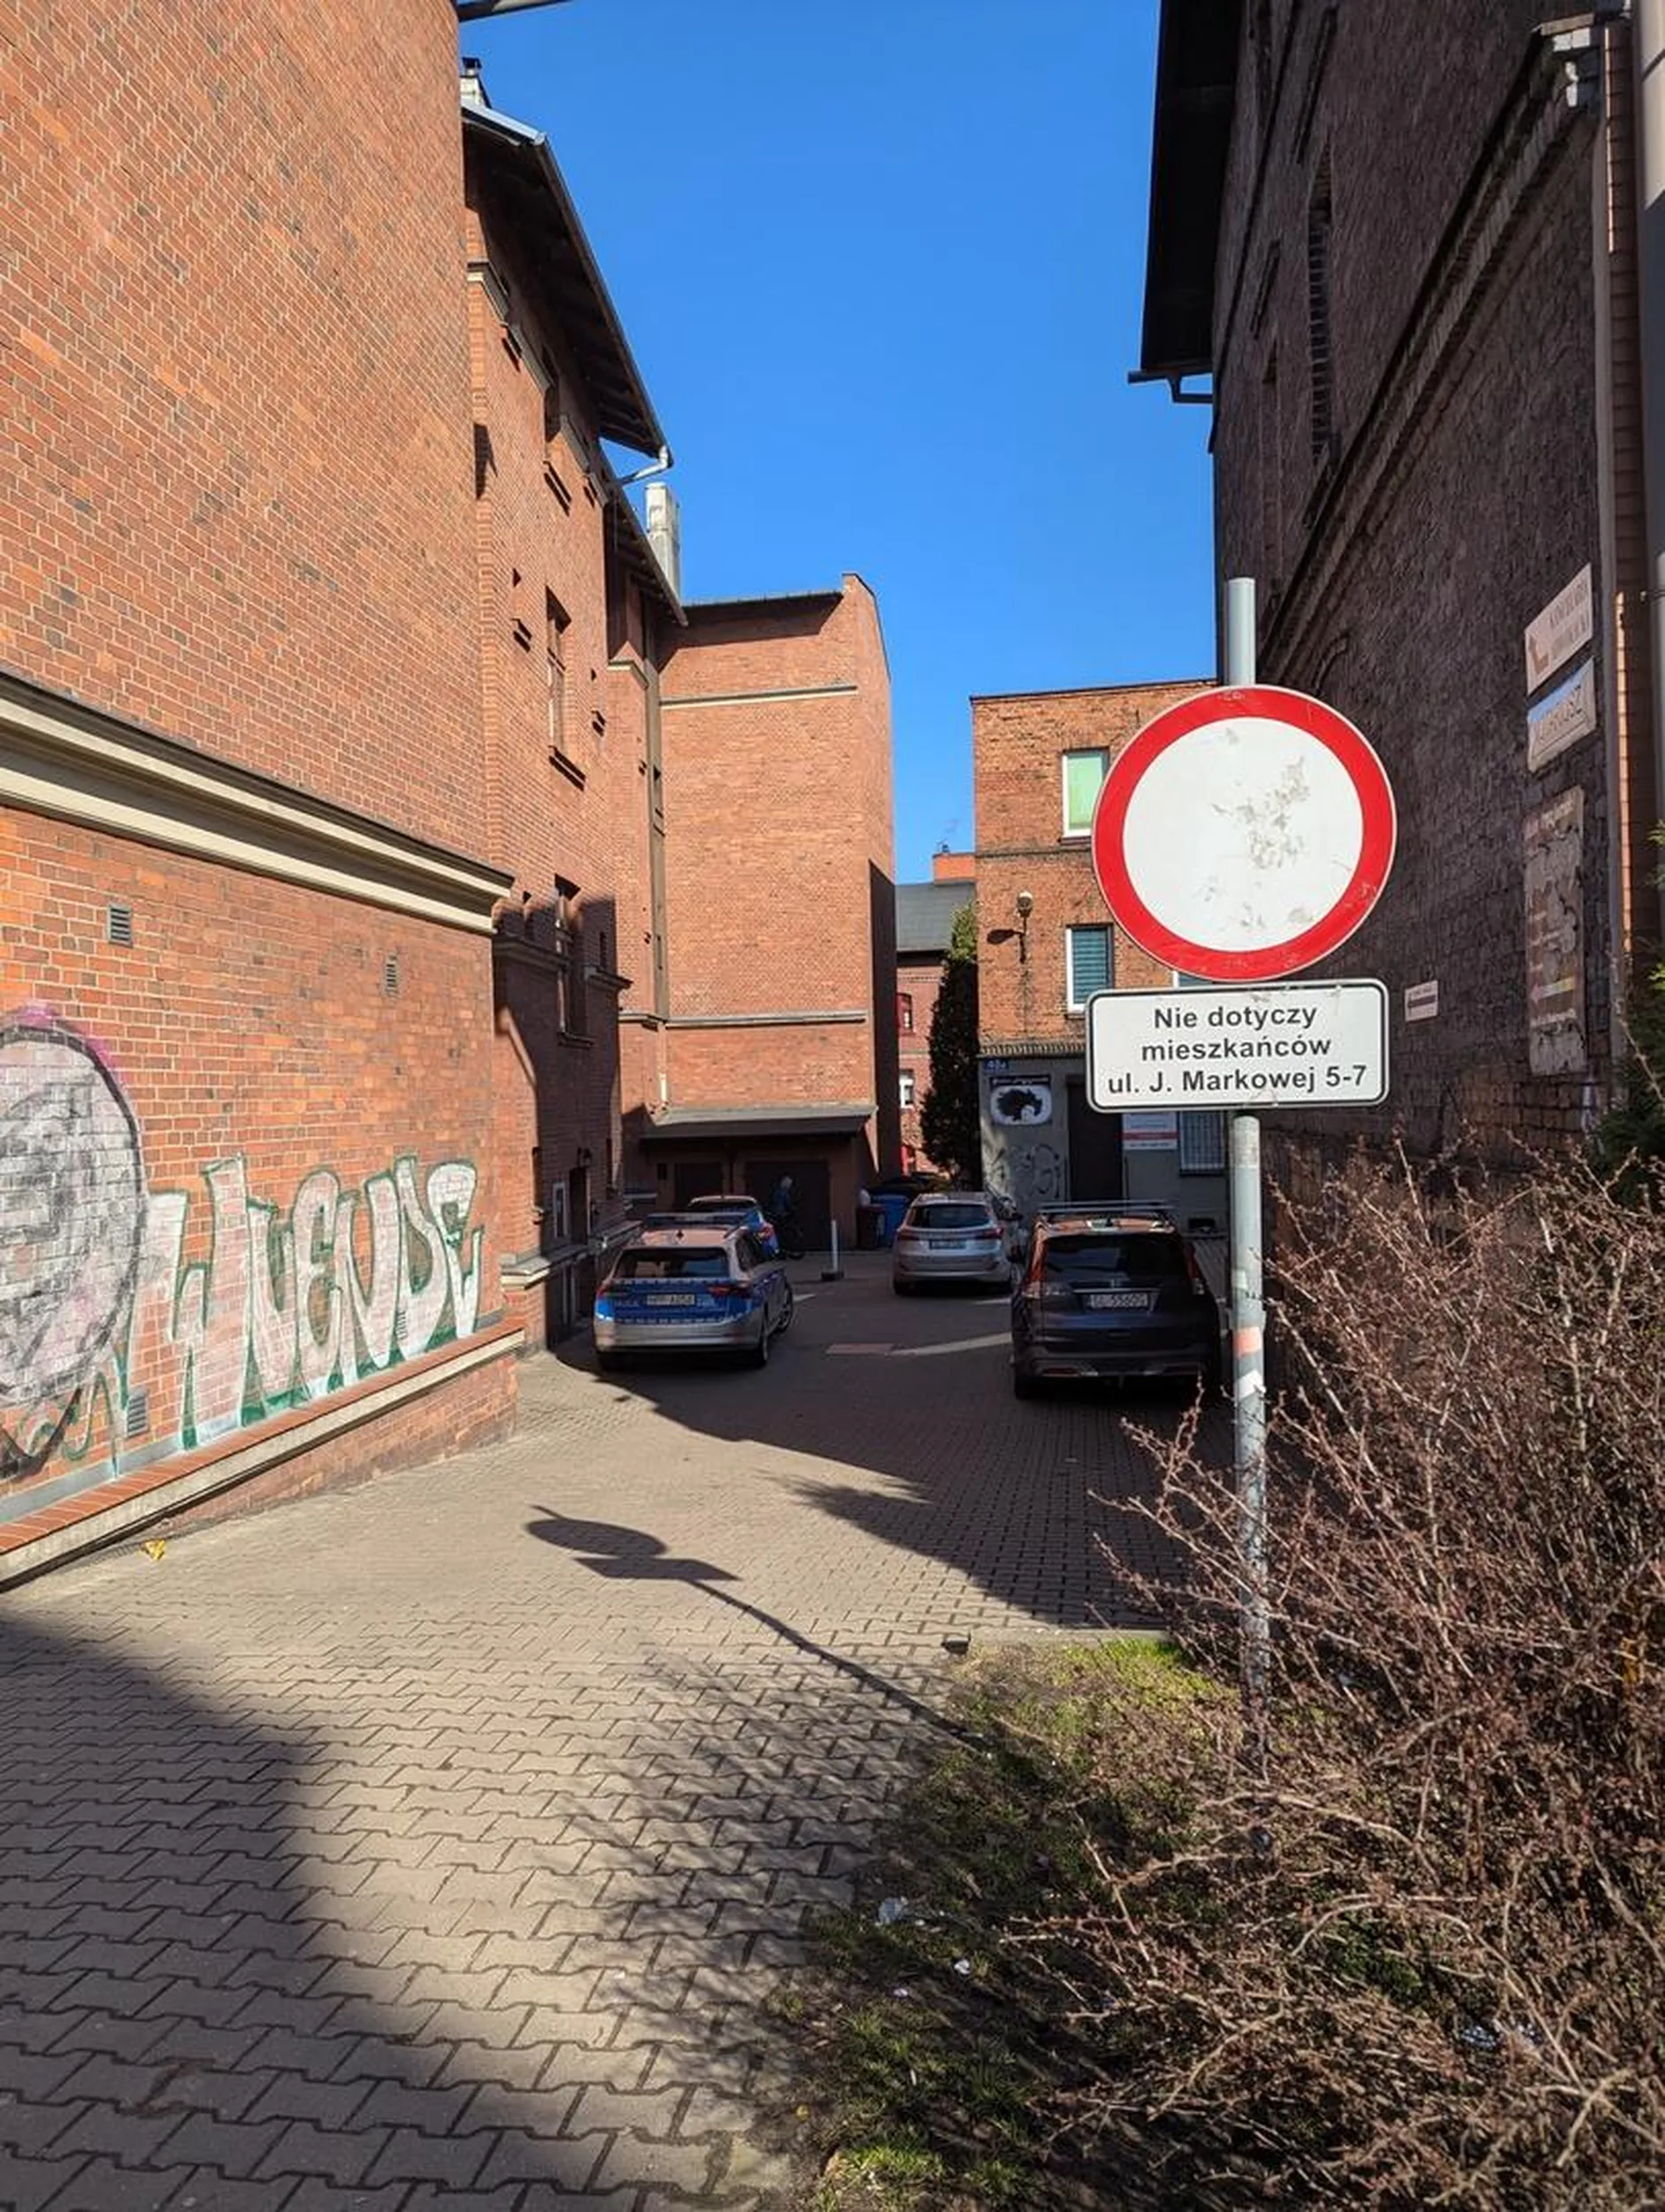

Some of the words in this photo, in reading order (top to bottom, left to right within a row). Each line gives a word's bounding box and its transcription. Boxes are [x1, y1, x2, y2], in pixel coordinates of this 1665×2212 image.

[1154, 1008, 1198, 1029] Nie
[1208, 1006, 1317, 1032] dotyczy
[1141, 1034, 1331, 1062] mieszkańców
[1108, 1073, 1139, 1094] ul.
[1149, 1071, 1172, 1093] J.
[1183, 1065, 1316, 1093] Markowej
[1325, 1065, 1368, 1087] 5-7
